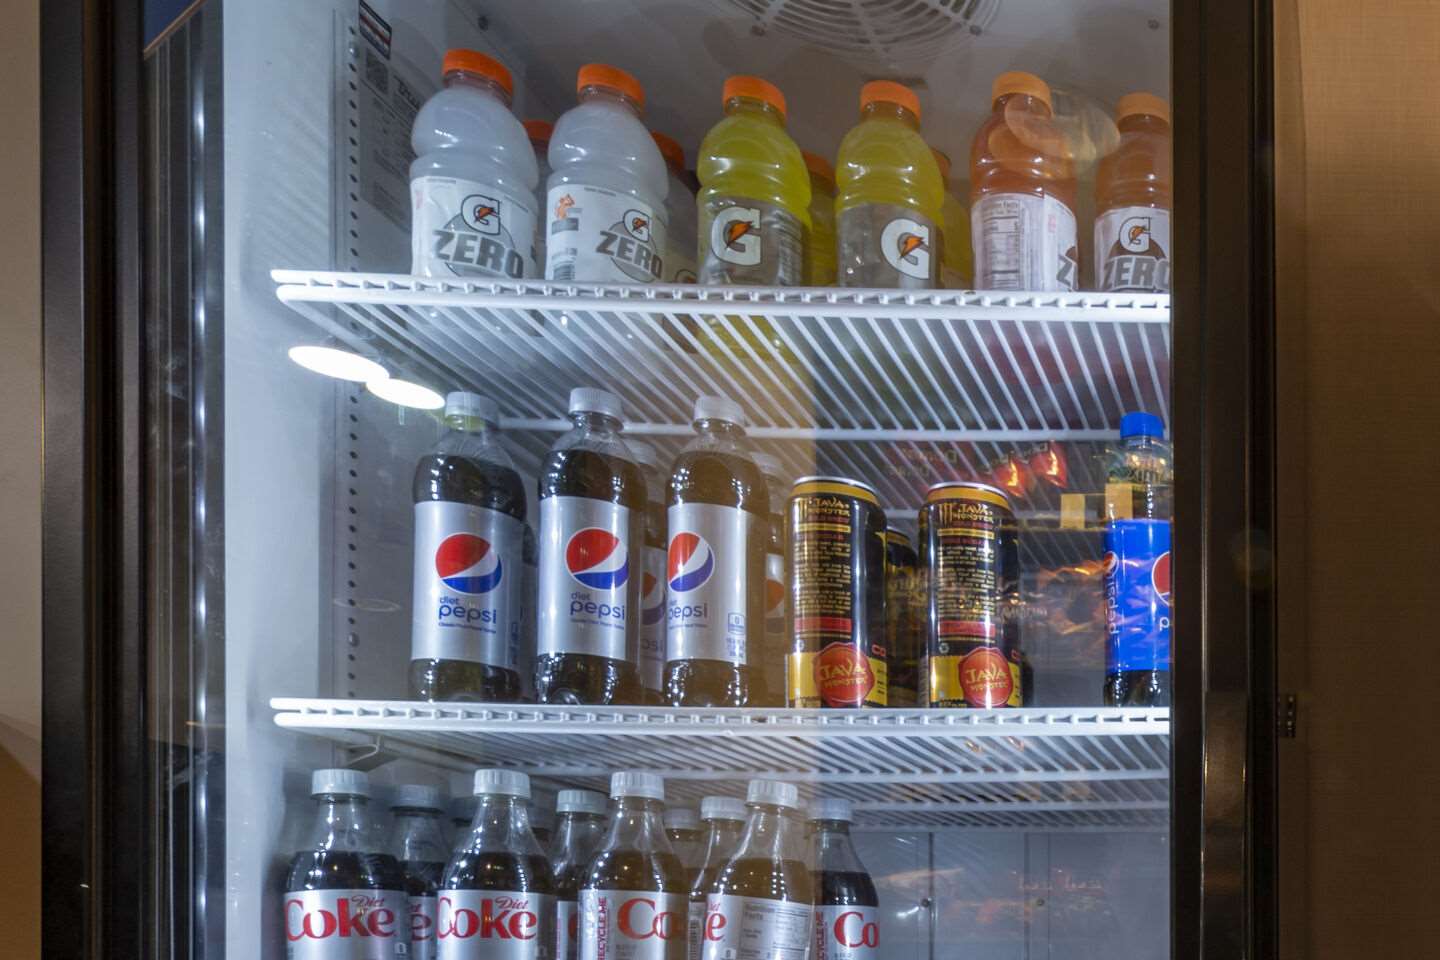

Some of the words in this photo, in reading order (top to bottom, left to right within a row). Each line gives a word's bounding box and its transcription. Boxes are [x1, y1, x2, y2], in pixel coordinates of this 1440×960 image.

[711, 207, 762, 266] G
[880, 218, 930, 280] G
[431, 229, 524, 279] ZERO
[595, 229, 663, 280] ZERO
[1102, 255, 1170, 291] ZERO
[438, 603, 497, 624] pepsi
[570, 600, 625, 621] pepsi
[819, 657, 867, 680] JAVA
[965, 663, 1007, 683] JAVA
[351, 894, 385, 909] Diet
[494, 895, 530, 911] Diet
[597, 896, 608, 914] ME
[284, 897, 395, 942] Coke
[436, 896, 537, 942] Coke
